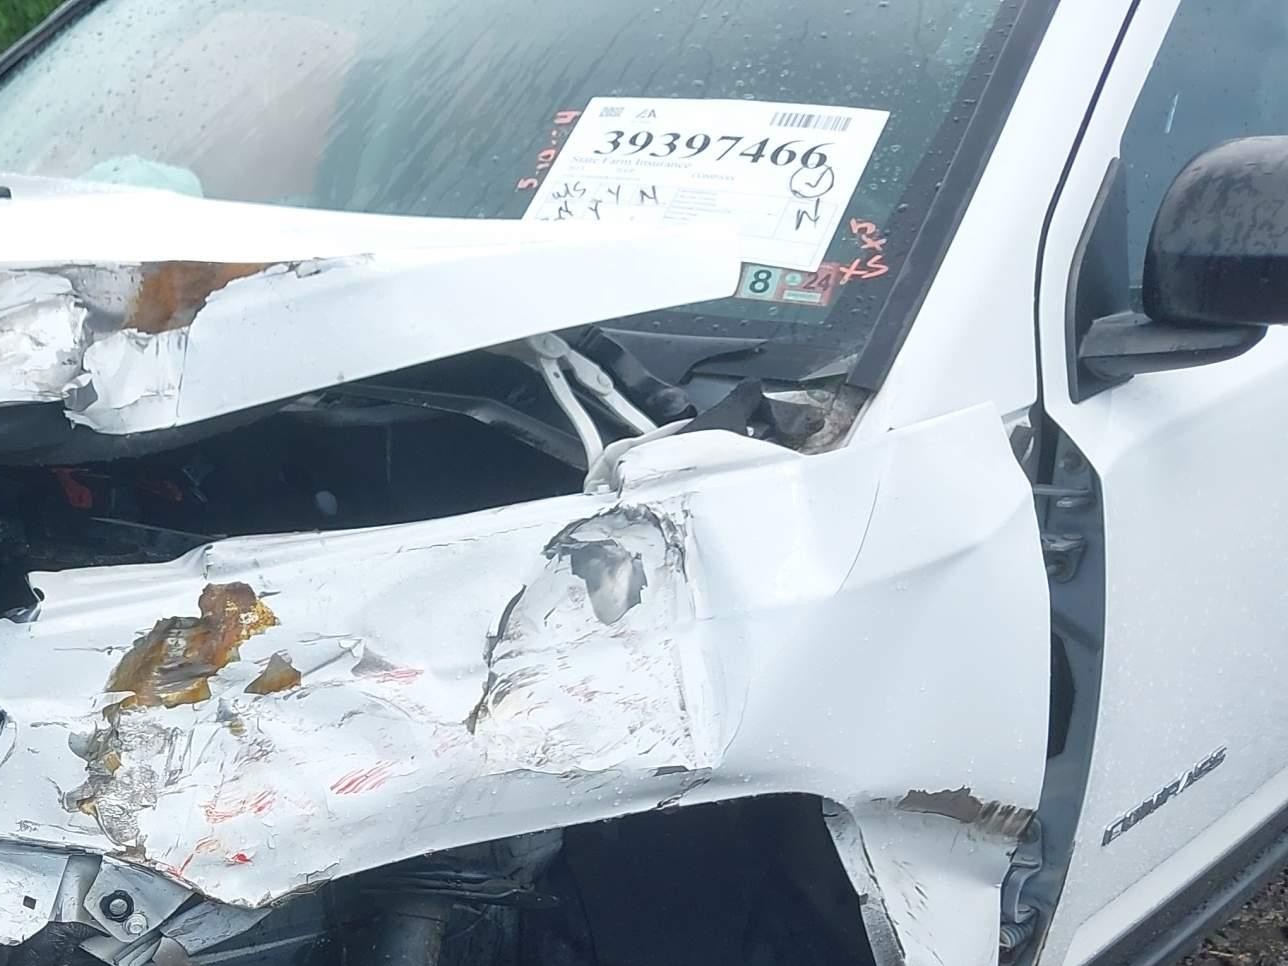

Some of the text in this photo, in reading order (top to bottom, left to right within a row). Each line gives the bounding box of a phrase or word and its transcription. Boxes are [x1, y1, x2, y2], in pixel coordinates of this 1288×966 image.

[593, 129, 836, 169] 39397466
[749, 269, 833, 293] 8 24
